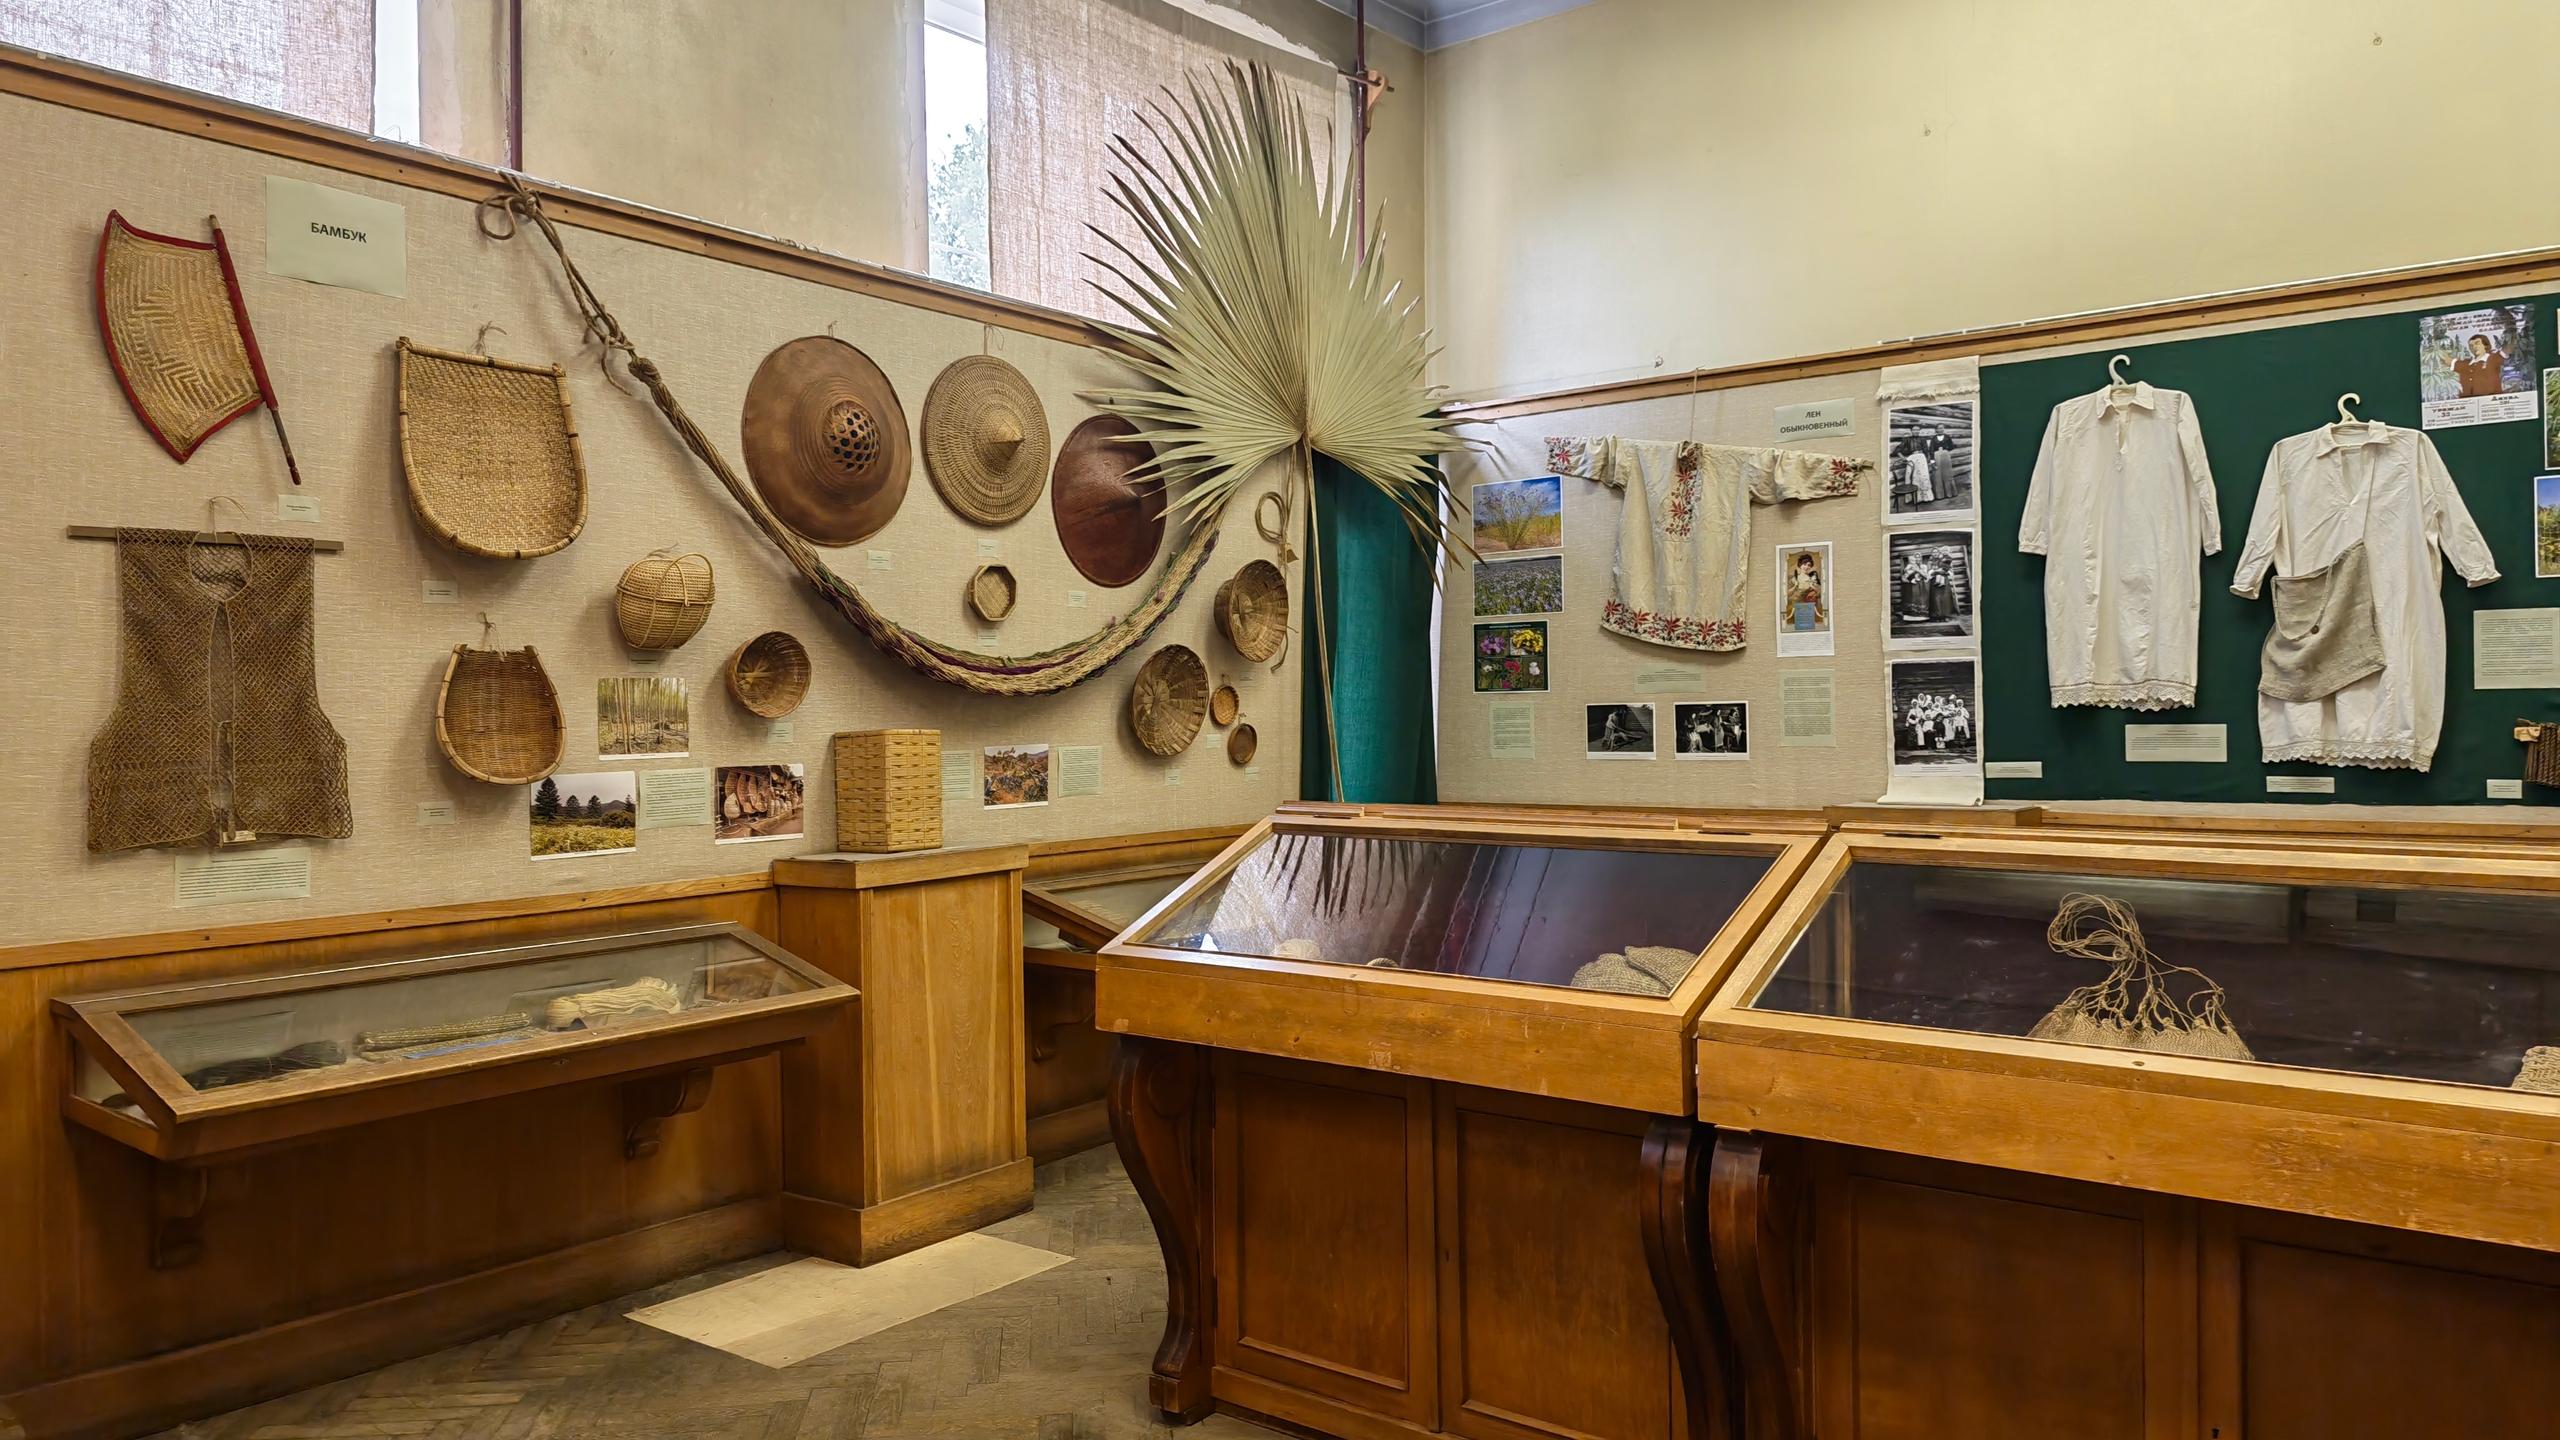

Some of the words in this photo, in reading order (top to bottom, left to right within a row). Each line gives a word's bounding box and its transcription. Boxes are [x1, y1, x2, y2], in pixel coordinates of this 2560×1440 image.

[311, 222, 367, 243] БАМБУК
[1805, 410, 1821, 418] ЛЕН
[1780, 418, 1849, 433] ОБЫКНОВЕННЫЙ
